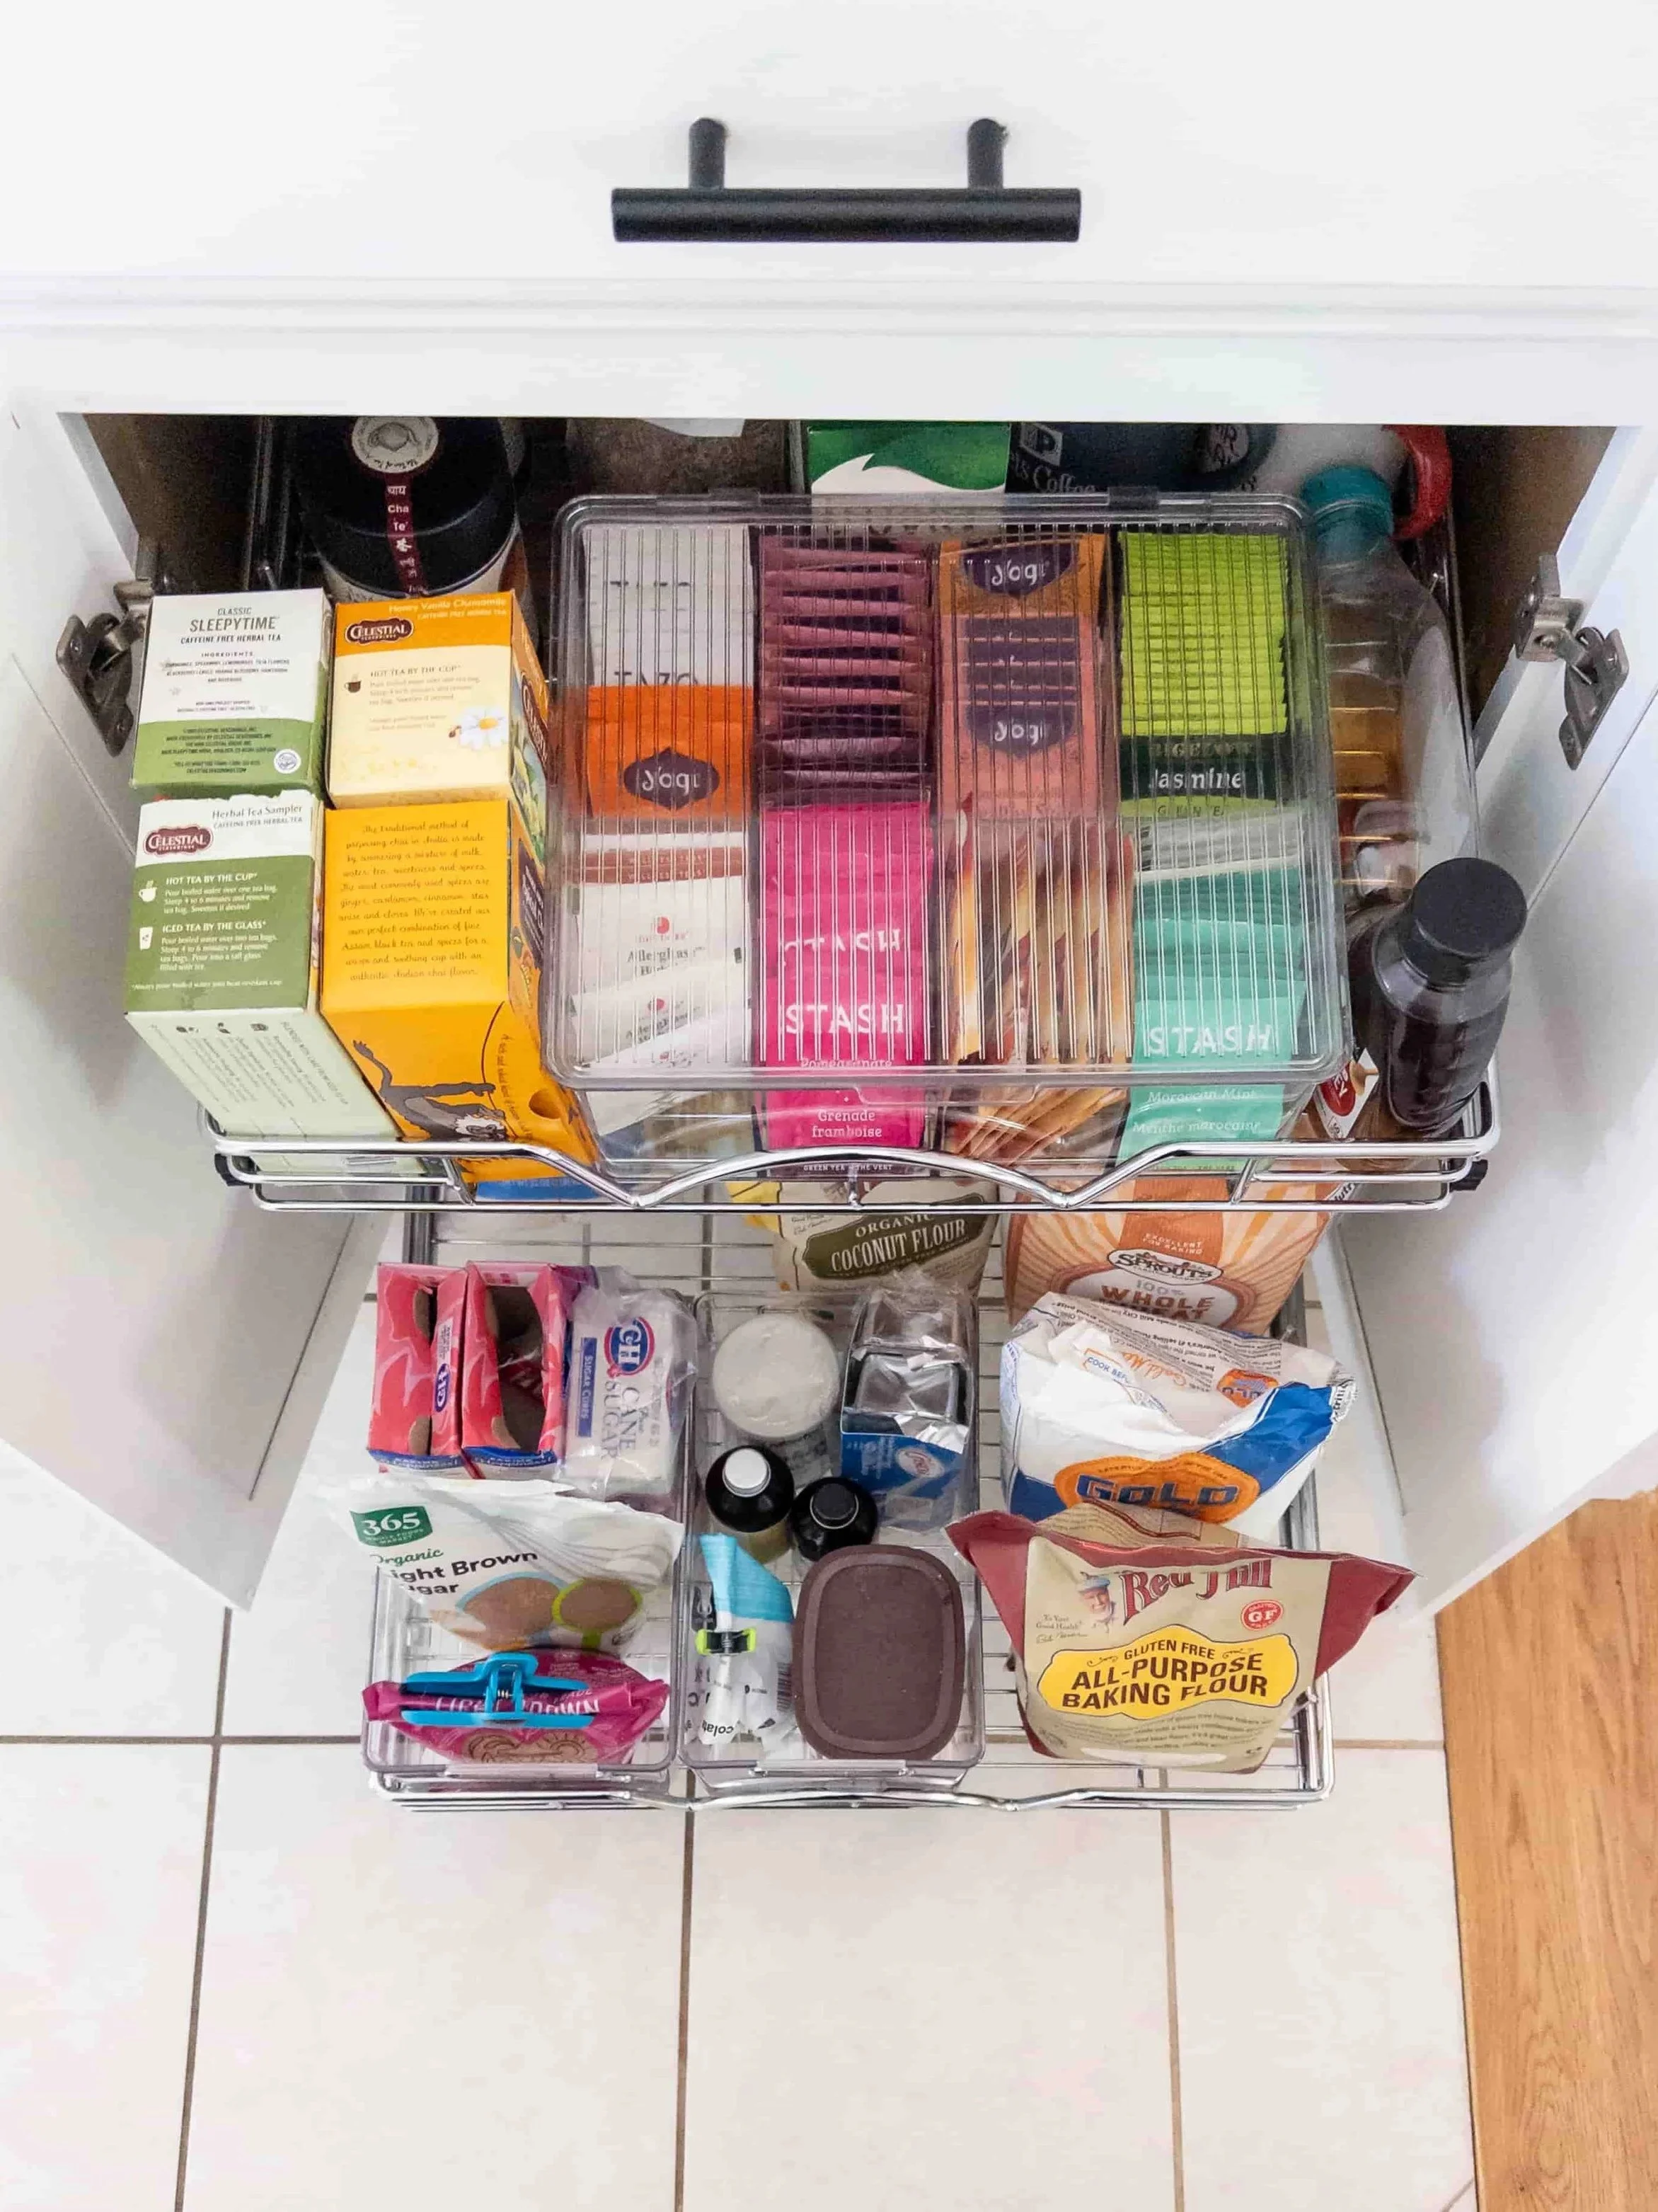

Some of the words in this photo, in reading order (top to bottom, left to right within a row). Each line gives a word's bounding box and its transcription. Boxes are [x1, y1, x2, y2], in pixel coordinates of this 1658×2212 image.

[388, 505, 409, 513] Cha
[218, 607, 252, 616] CLASSIC
[190, 617, 276, 632] SLEEPYTIME
[350, 621, 406, 640] CELESTIAL
[212, 809, 244, 819] Herbal
[248, 808, 263, 817] Tea
[265, 805, 302, 816] Sampler
[149, 833, 207, 849] CELESTIAL
[166, 877, 183, 886] HOT
[162, 924, 183, 933] ICED
[185, 924, 201, 932] TEA
[785, 1003, 904, 1034] STASH
[1148, 1024, 1276, 1055] STASH
[818, 1109, 876, 1123] Grenade
[855, 1213, 935, 1238] ORGANIC
[831, 1232, 907, 1272] COCONUT
[911, 1218, 966, 1253] FLOUR
[1101, 1285, 1215, 1312] WHOLE
[1087, 1356, 1110, 1373] COOK
[1076, 1474, 1238, 1506] GOLD
[362, 1512, 420, 1536] 365
[391, 1567, 445, 1583] ight
[451, 1552, 539, 1576] Brown
[1124, 1639, 1177, 1661] GLUTEN
[1181, 1643, 1216, 1660] FREE
[1071, 1652, 1264, 1690] ALL-PURPOSE
[1061, 1681, 1170, 1709] BAKING
[1180, 1674, 1268, 1702] FLOUR
